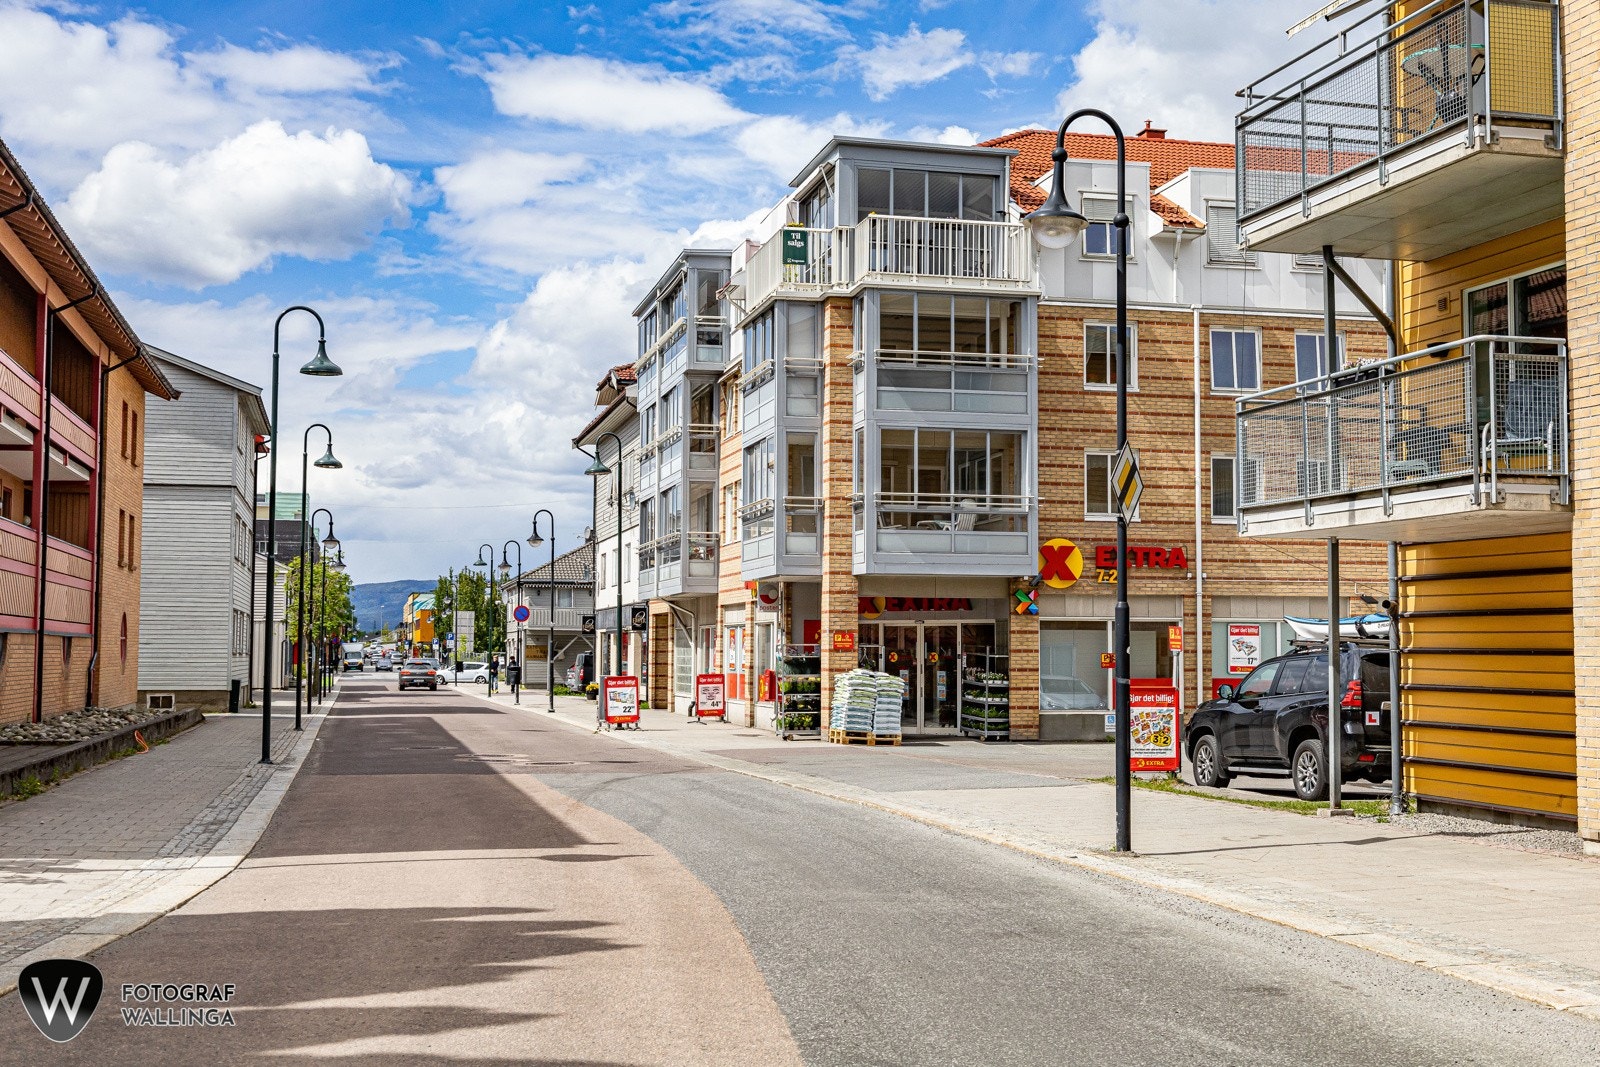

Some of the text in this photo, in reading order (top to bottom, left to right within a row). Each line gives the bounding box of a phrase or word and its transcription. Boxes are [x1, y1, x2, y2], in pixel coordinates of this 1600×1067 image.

[791, 232, 801, 240] Til
[787, 240, 805, 248] salgs
[1040, 546, 1078, 581] X
[1096, 569, 1118, 584] 7-2
[1143, 694, 1154, 702] det
[1156, 694, 1174, 703] billig!
